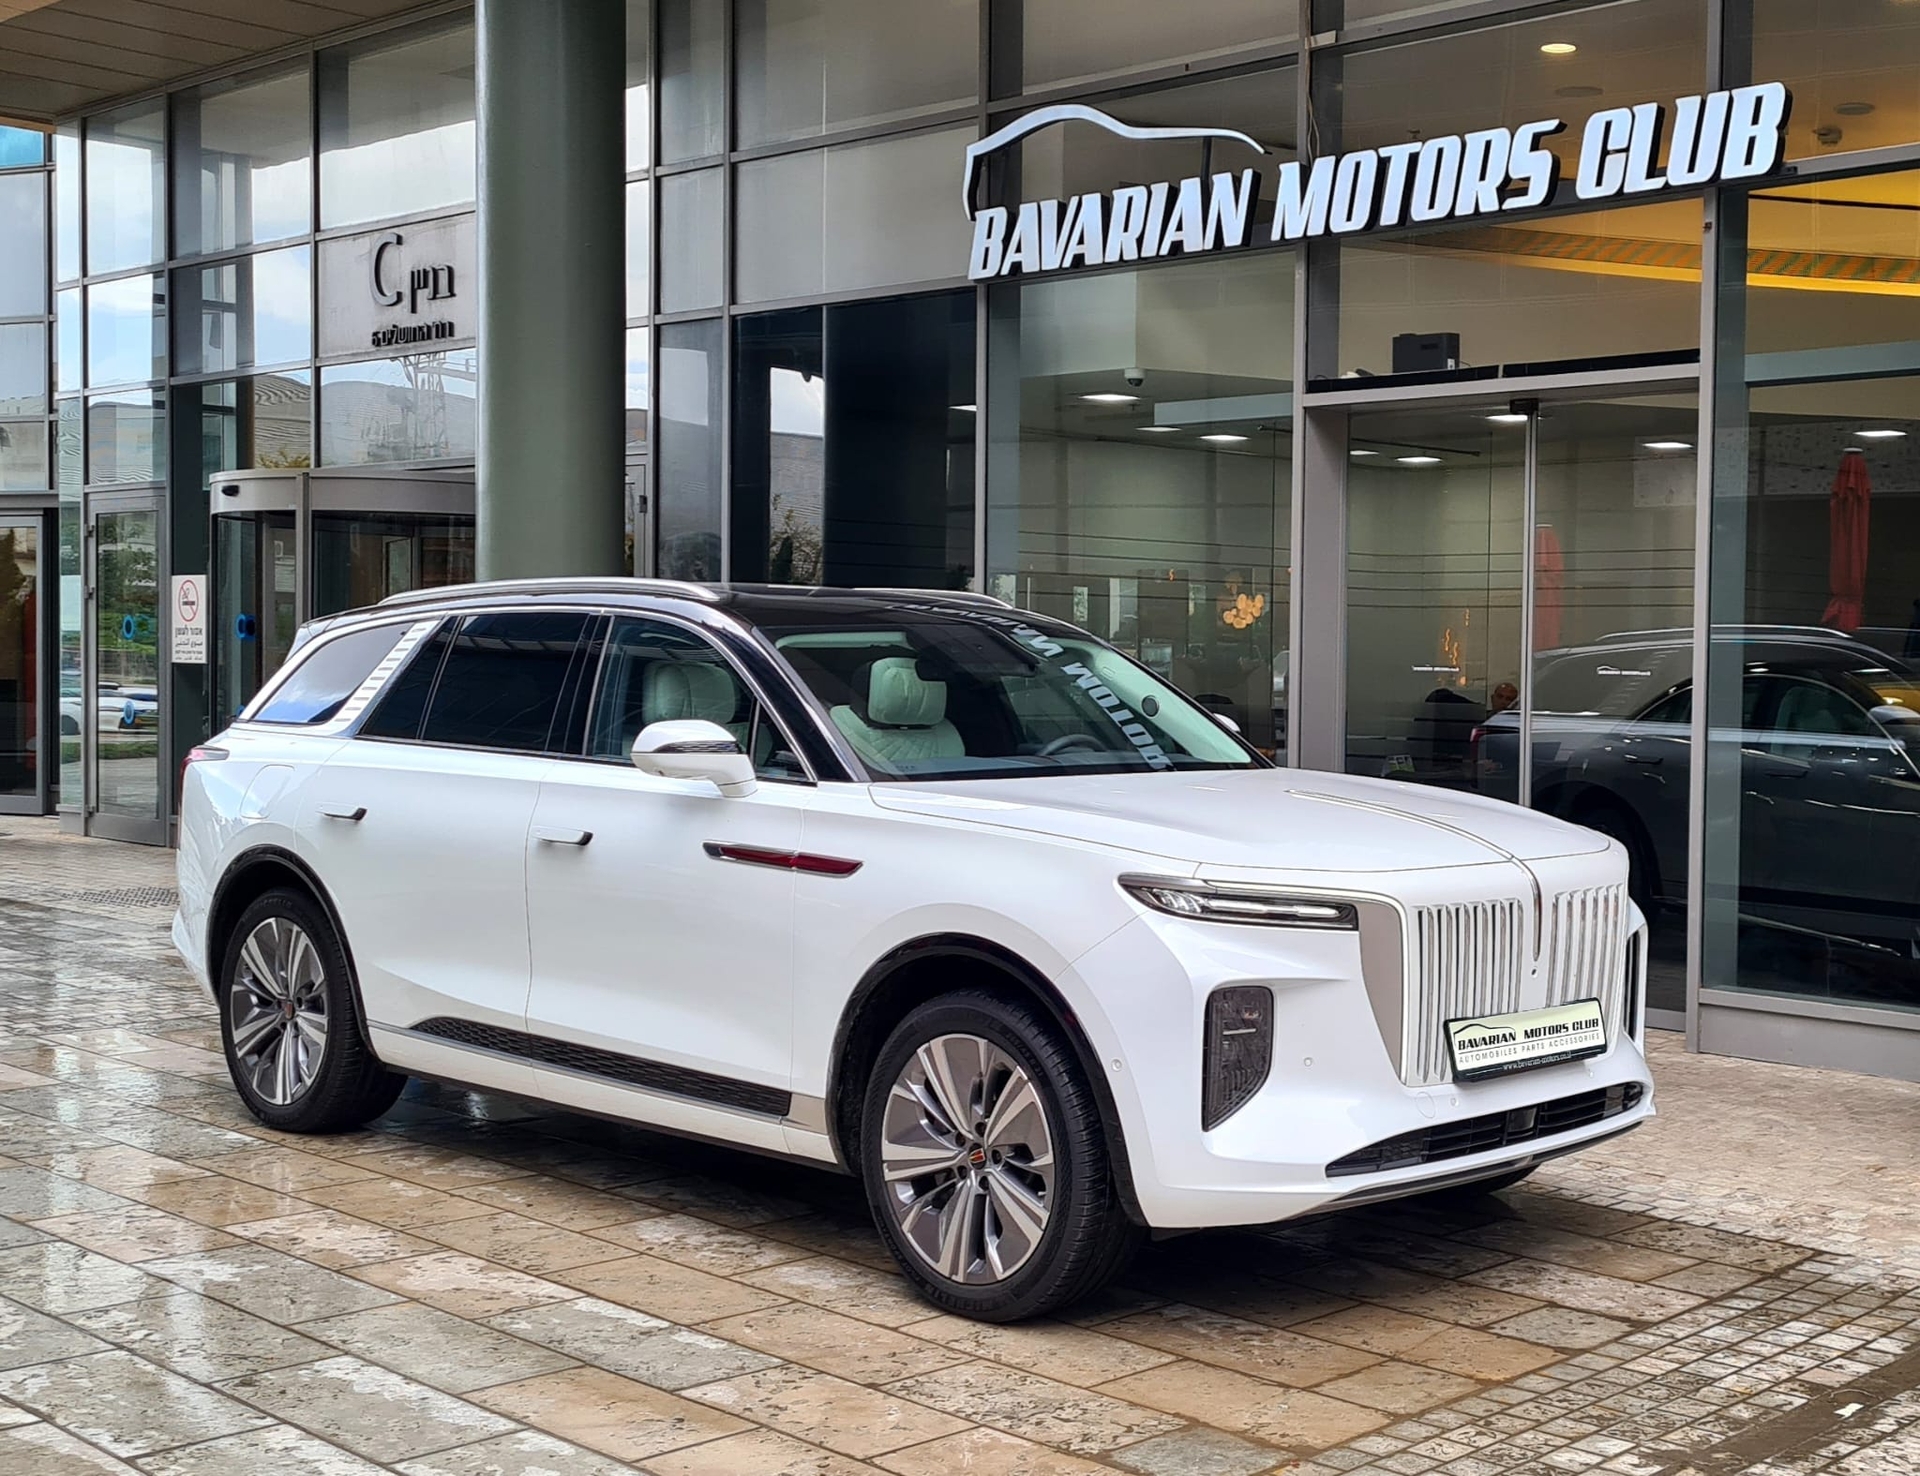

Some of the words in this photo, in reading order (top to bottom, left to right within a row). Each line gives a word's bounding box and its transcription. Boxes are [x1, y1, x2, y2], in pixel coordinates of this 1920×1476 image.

[967, 168, 1254, 281] BAVARIAN
[1270, 119, 1563, 240] MOTORS
[1575, 82, 1788, 200] CLUB
[369, 231, 404, 307] C
[1458, 1032, 1516, 1051] BAVARIAN
[1523, 1023, 1569, 1040] MOTORS
[1572, 1018, 1599, 1032] CLUB
[1459, 1047, 1517, 1063] AUTOMOBILES
[1521, 1042, 1545, 1052] PARTS
[1548, 1032, 1600, 1048] ACCESSORIES
